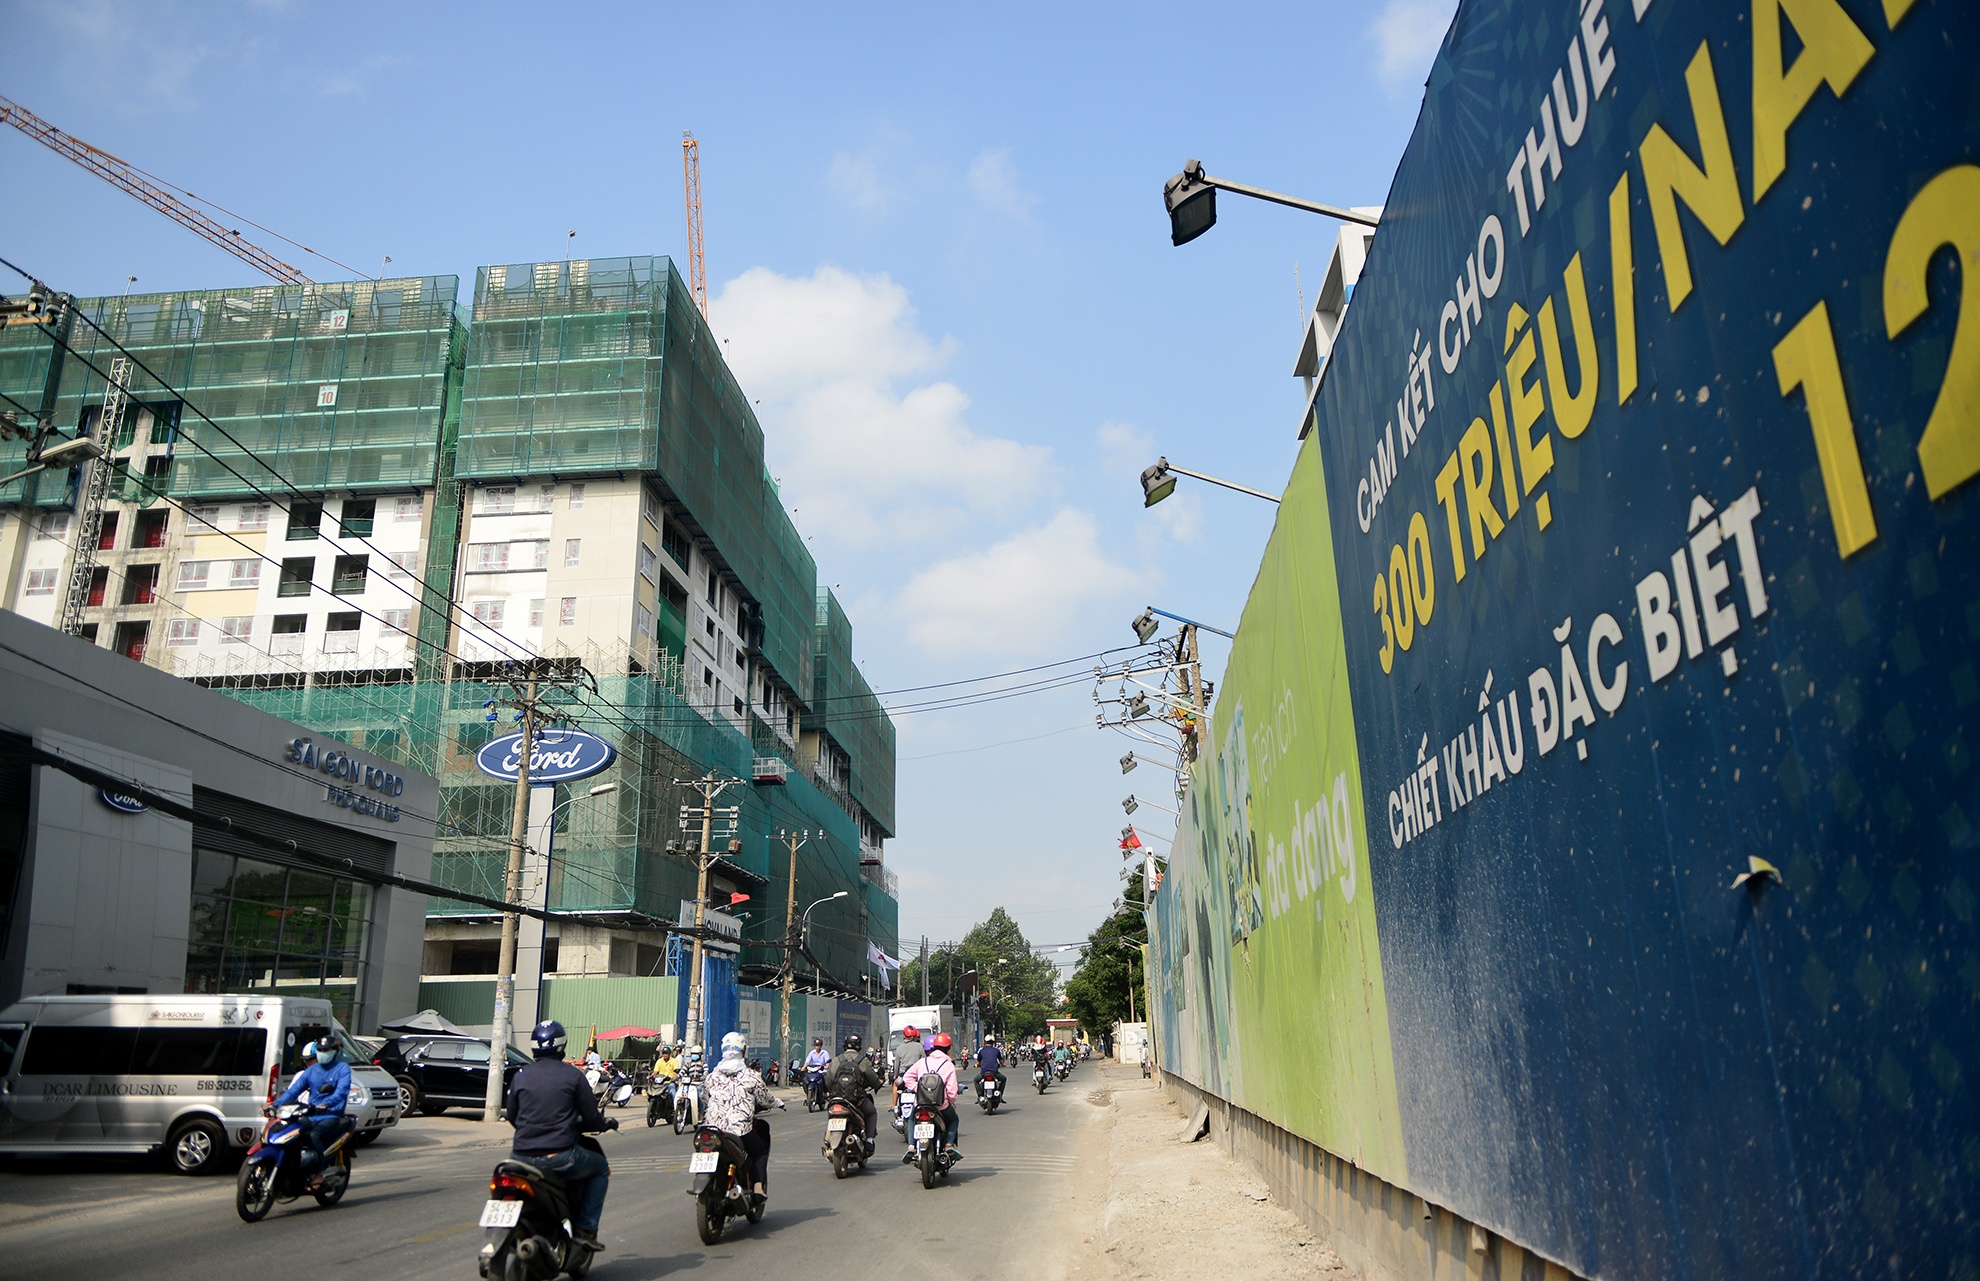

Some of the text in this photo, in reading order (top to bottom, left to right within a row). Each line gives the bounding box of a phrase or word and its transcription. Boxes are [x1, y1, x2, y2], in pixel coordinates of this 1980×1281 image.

[333, 315, 346, 328] 12
[321, 391, 334, 404] 10
[1357, 420, 1398, 534] CAM
[1397, 328, 1435, 459] KẾT
[1439, 214, 1505, 374] CHO
[1373, 511, 1435, 675] 300
[1388, 486, 1768, 850] CHIẾT KHẤU ĐẶC BIỆT
[287, 738, 404, 797] SÀI GÒN FORD
[502, 736, 583, 772] Ford
[1291, 770, 1357, 922] dạng
[43, 1083, 178, 1096] DCAR LIMOUSINE
